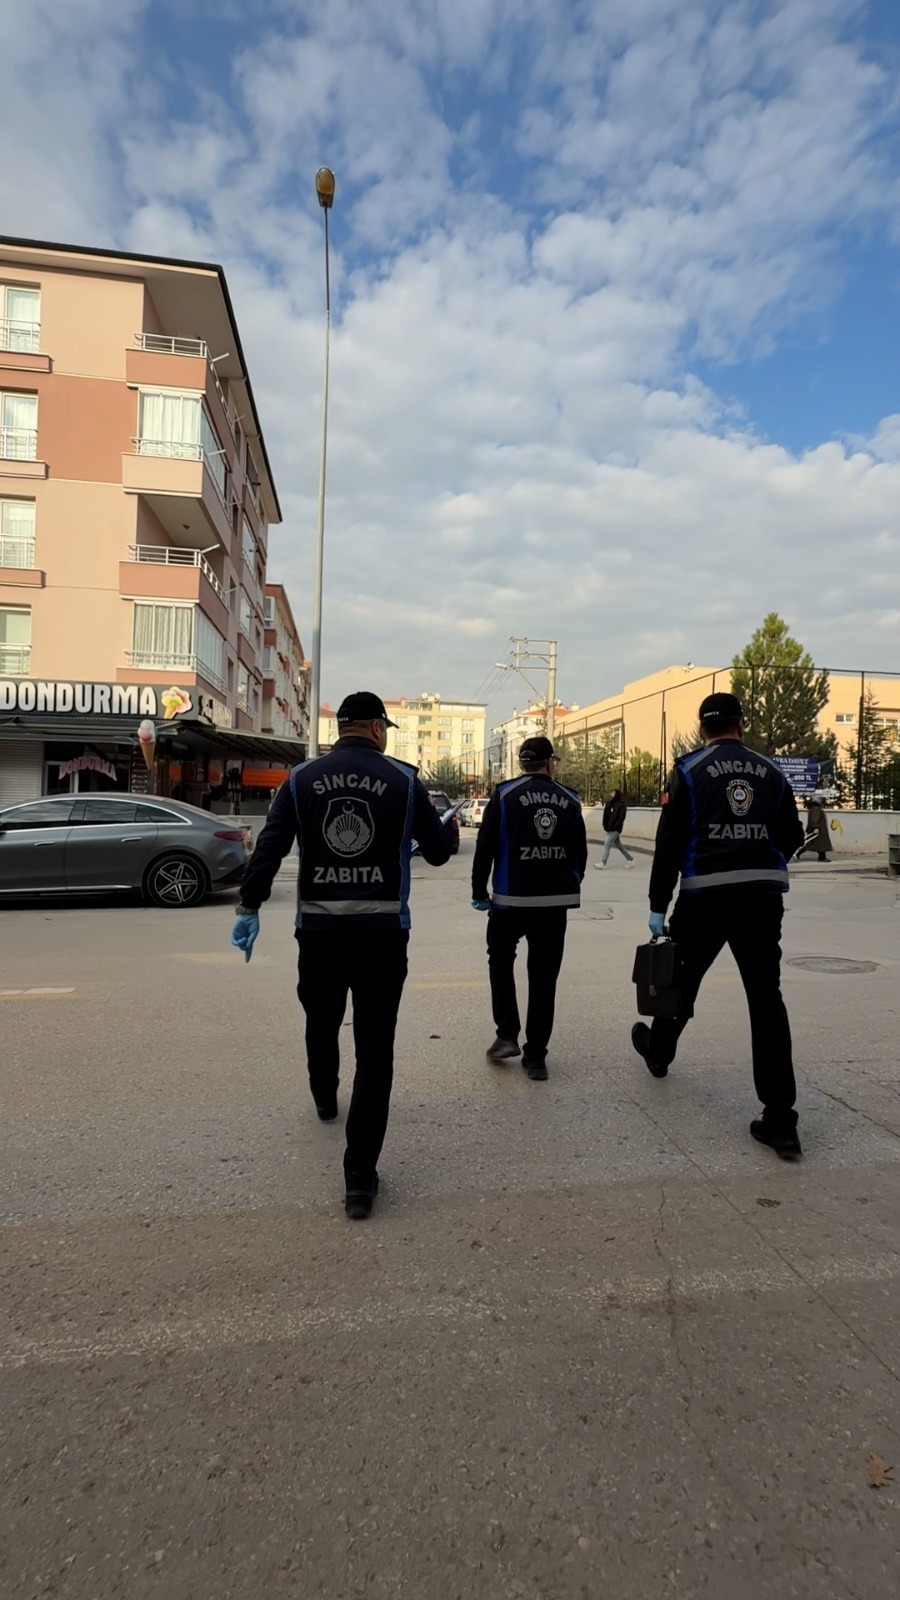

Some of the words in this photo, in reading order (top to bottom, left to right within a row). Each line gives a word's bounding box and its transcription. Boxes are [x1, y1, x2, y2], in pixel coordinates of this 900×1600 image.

[0, 681, 157, 716] DONDURMA
[707, 759, 768, 779] SİNCAN
[313, 773, 388, 797] SİNCAN
[519, 790, 570, 809] SİNCAN
[708, 823, 769, 840] ZABITA
[519, 846, 567, 861] ZABITA
[313, 866, 384, 884] ZABITA
